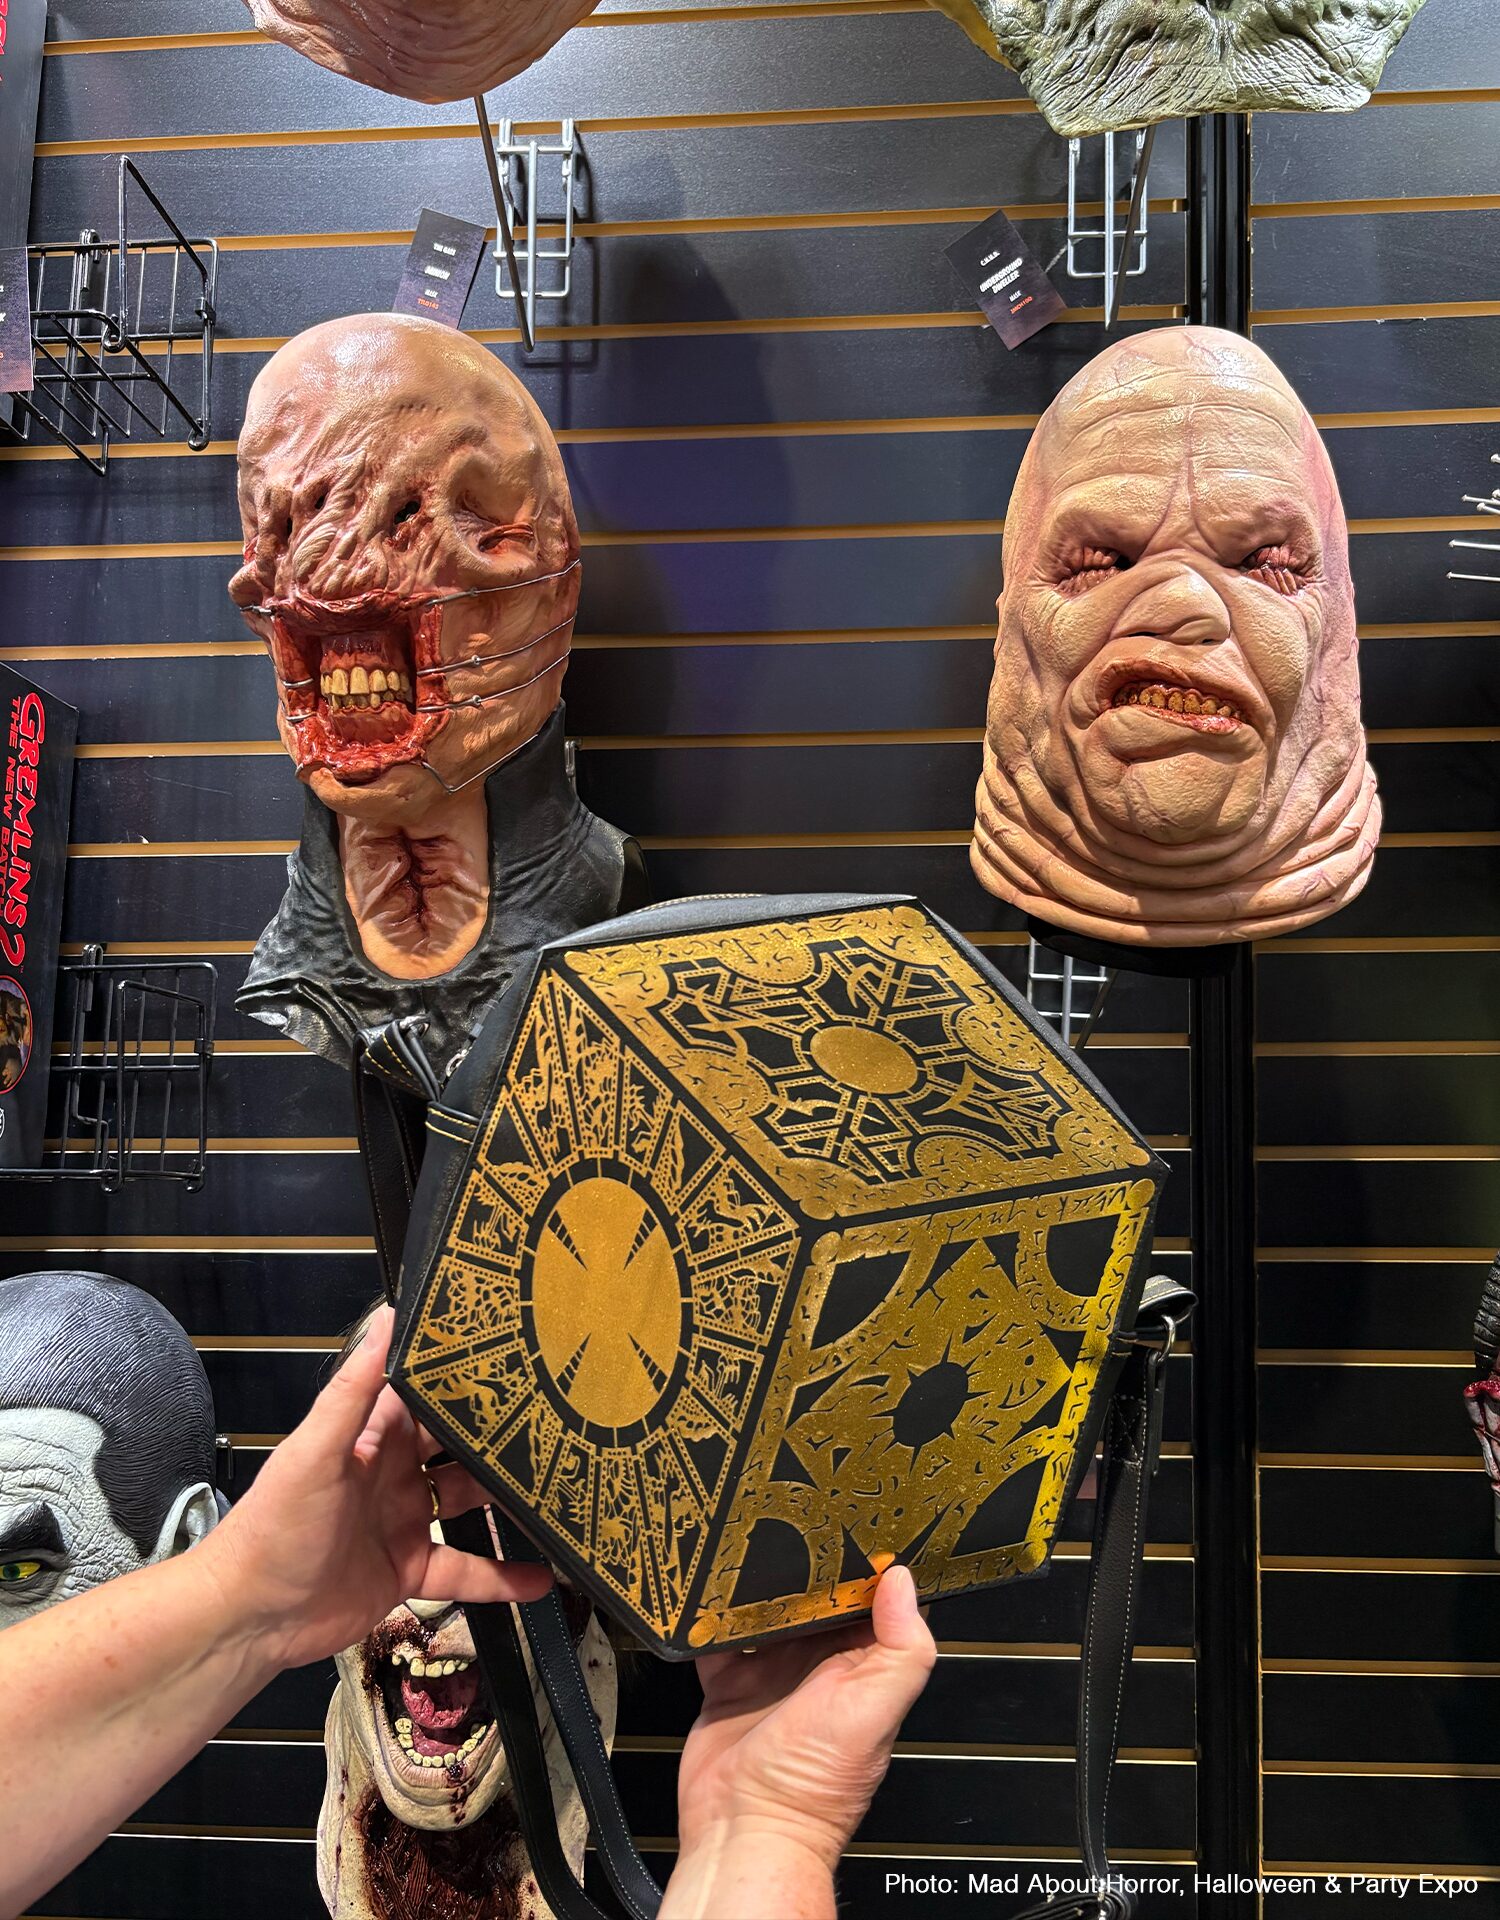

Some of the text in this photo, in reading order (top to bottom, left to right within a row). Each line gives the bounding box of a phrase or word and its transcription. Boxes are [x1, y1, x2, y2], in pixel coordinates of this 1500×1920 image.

[979, 257, 1023, 293] UNDERGROUND
[991, 270, 1020, 294] DWELLER
[9, 695, 21, 749] THE
[3, 757, 17, 820] NEW
[0, 925, 26, 967] 2
